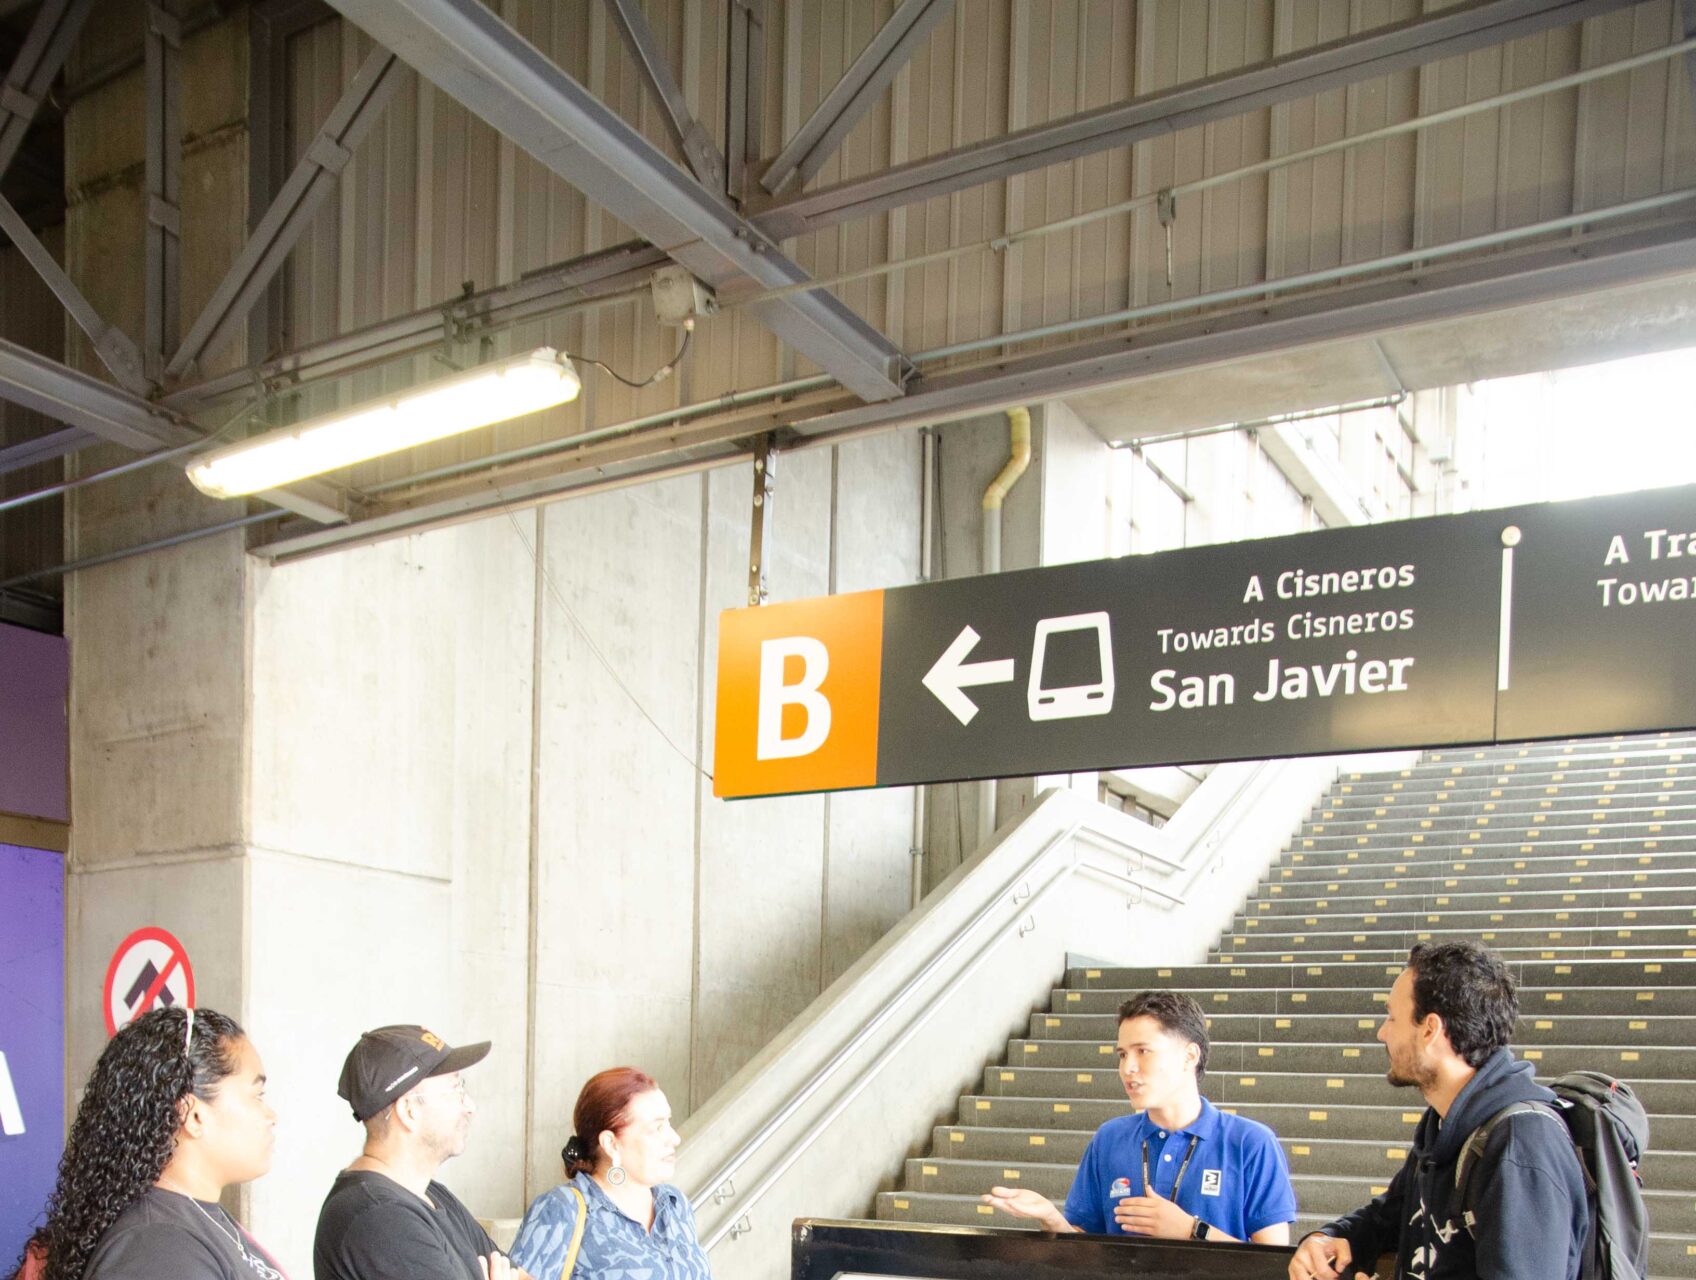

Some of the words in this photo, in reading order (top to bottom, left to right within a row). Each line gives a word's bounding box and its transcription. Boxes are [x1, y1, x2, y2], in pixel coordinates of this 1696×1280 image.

[1604, 534, 1630, 566] A
[1243, 575, 1264, 603] A
[1276, 564, 1415, 600] Cisneros
[1157, 618, 1276, 654] Towards
[1287, 609, 1414, 640] Cisneros
[757, 636, 831, 760] B
[1149, 668, 1236, 713] San
[1253, 649, 1415, 704] Javier
